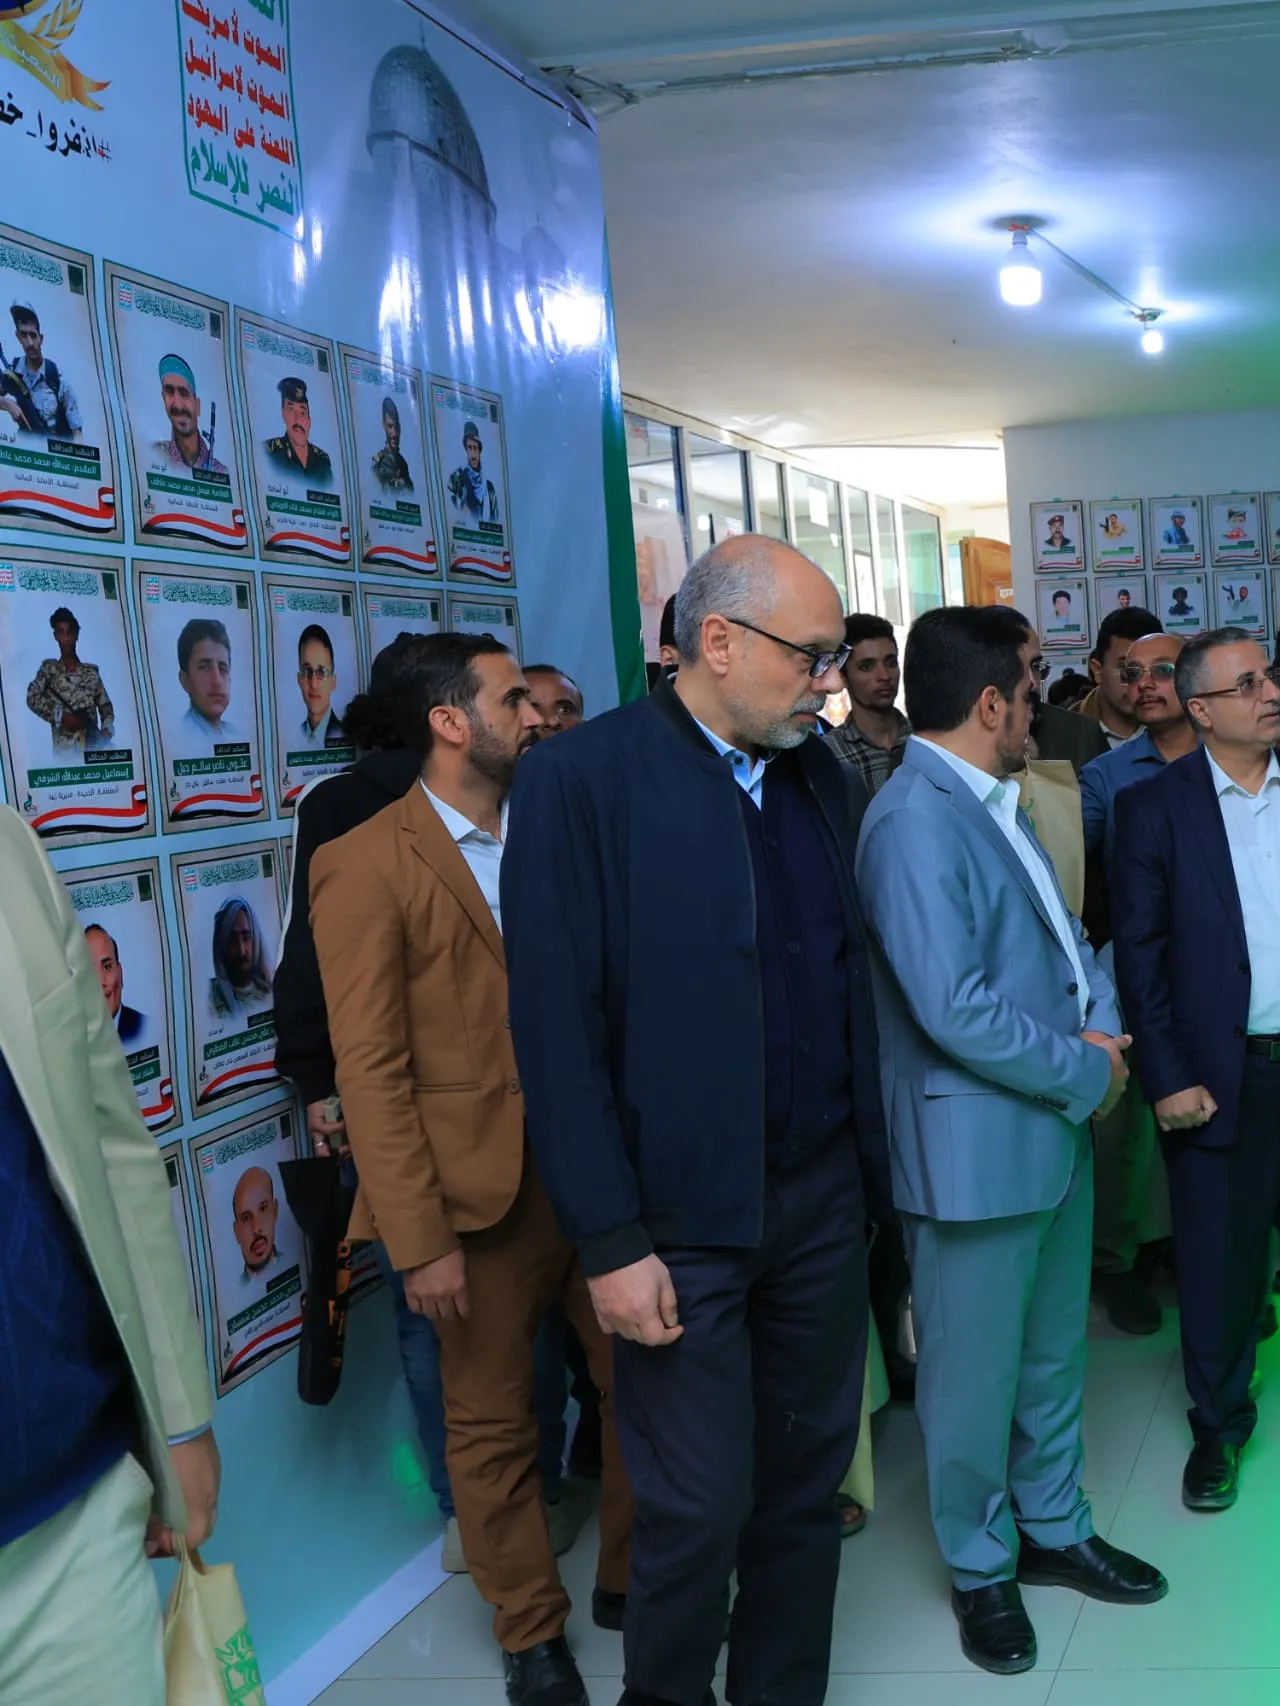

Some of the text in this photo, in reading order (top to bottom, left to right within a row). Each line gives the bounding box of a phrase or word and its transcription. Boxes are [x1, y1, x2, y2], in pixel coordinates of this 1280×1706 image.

[182, 0, 239, 46] لأمريك
[244, 30, 286, 76] الموت
[247, 78, 289, 122] الموت
[187, 92, 296, 168] اللعنة على اليهود
[191, 137, 249, 205] للإسلام
